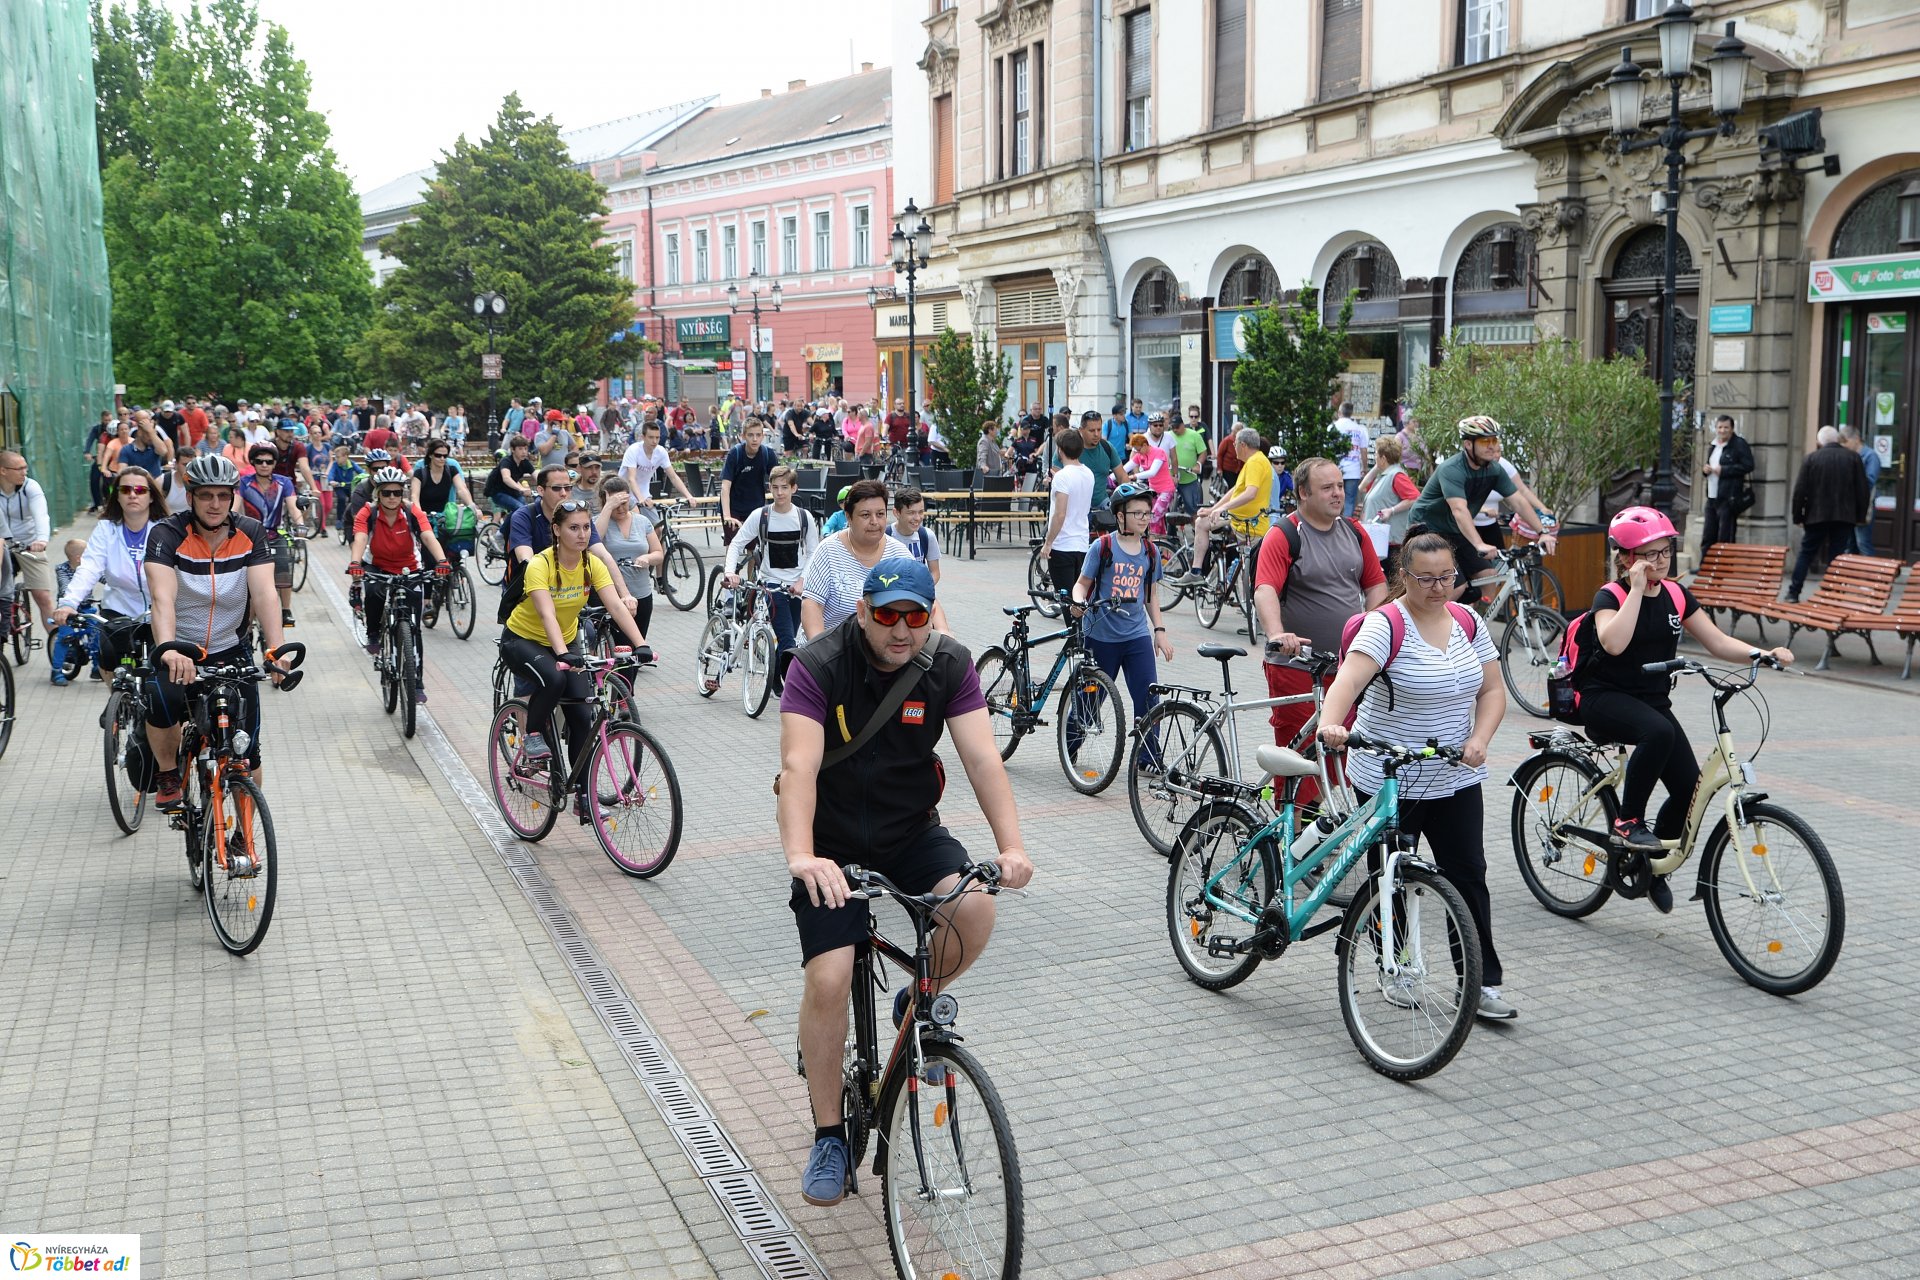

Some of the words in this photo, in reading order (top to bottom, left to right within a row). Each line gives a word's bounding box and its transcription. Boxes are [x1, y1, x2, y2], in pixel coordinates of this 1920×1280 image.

[1871, 269, 1894, 283] Foto
[1895, 267, 1920, 281] Cent
[1114, 562, 1135, 576] IT'S
[1136, 565, 1144, 577] A
[1112, 575, 1141, 588] GOOD
[1111, 586, 1140, 598] DAY
[904, 707, 924, 717] LEGO
